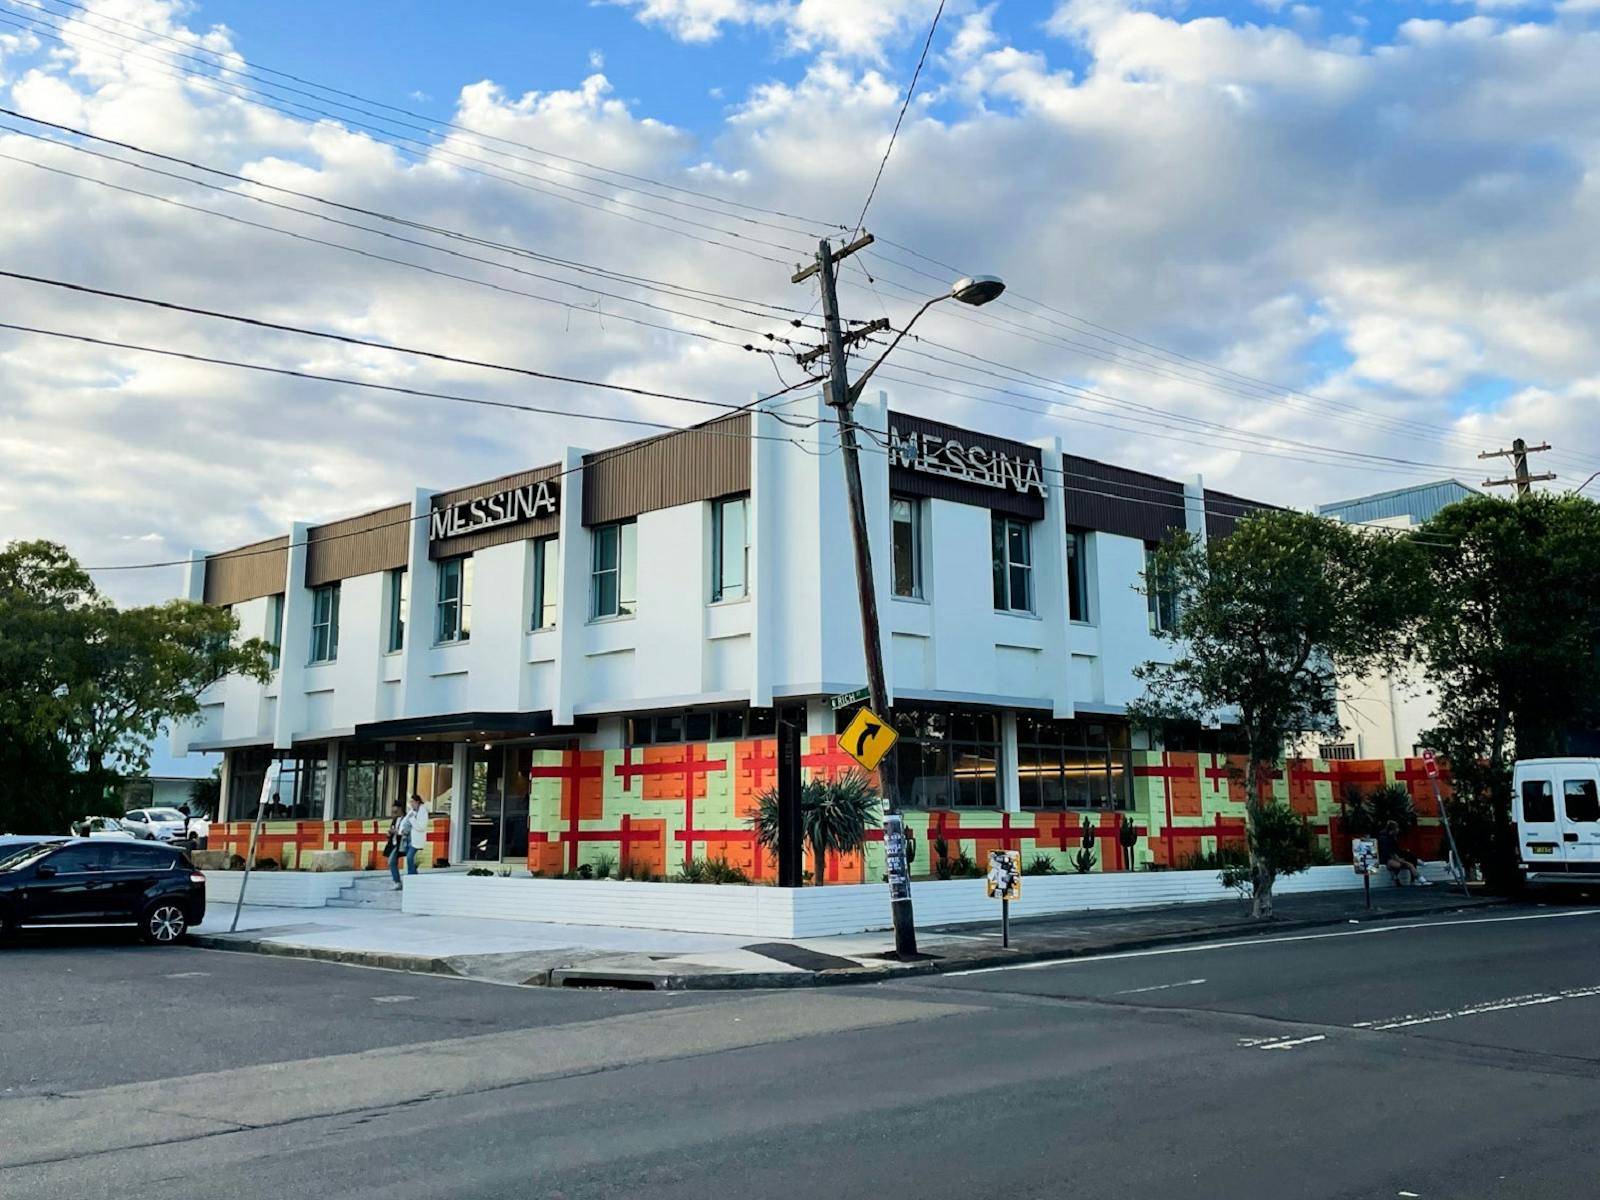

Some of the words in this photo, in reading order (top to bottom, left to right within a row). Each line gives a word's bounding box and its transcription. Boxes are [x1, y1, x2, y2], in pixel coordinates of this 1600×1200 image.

[888, 425, 1048, 498] MESSINA
[430, 481, 556, 541] MESSINA
[837, 694, 855, 706] RICH
